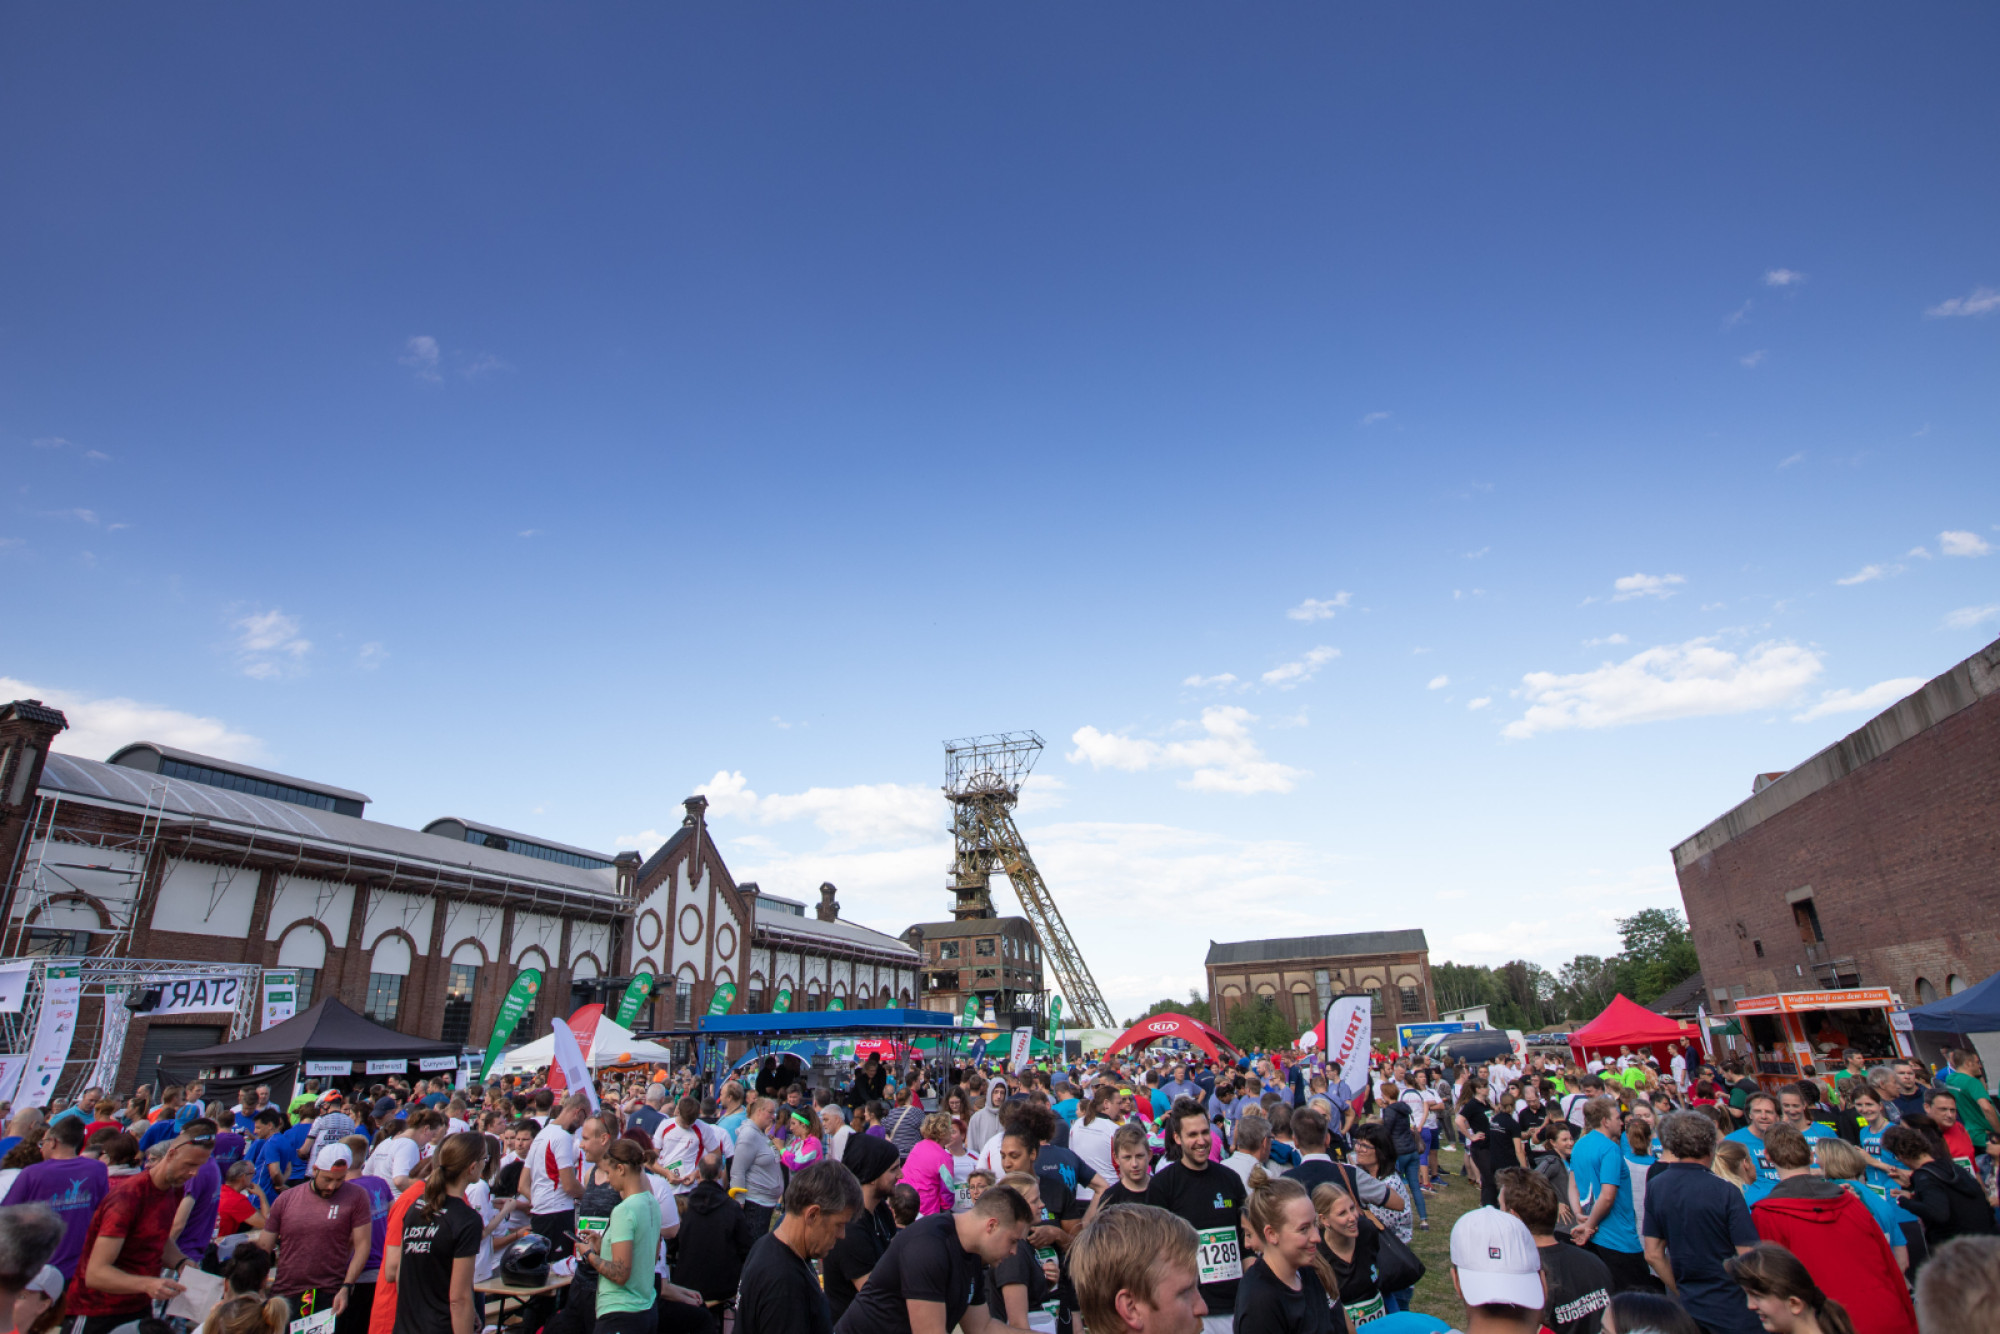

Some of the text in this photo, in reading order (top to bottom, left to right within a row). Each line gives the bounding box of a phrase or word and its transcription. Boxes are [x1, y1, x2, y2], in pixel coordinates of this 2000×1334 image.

[1153, 1023, 1174, 1031] KIA
[314, 1064, 344, 1072] Pommes
[404, 1226, 426, 1240] LOST
[1200, 1243, 1237, 1265] 1289
